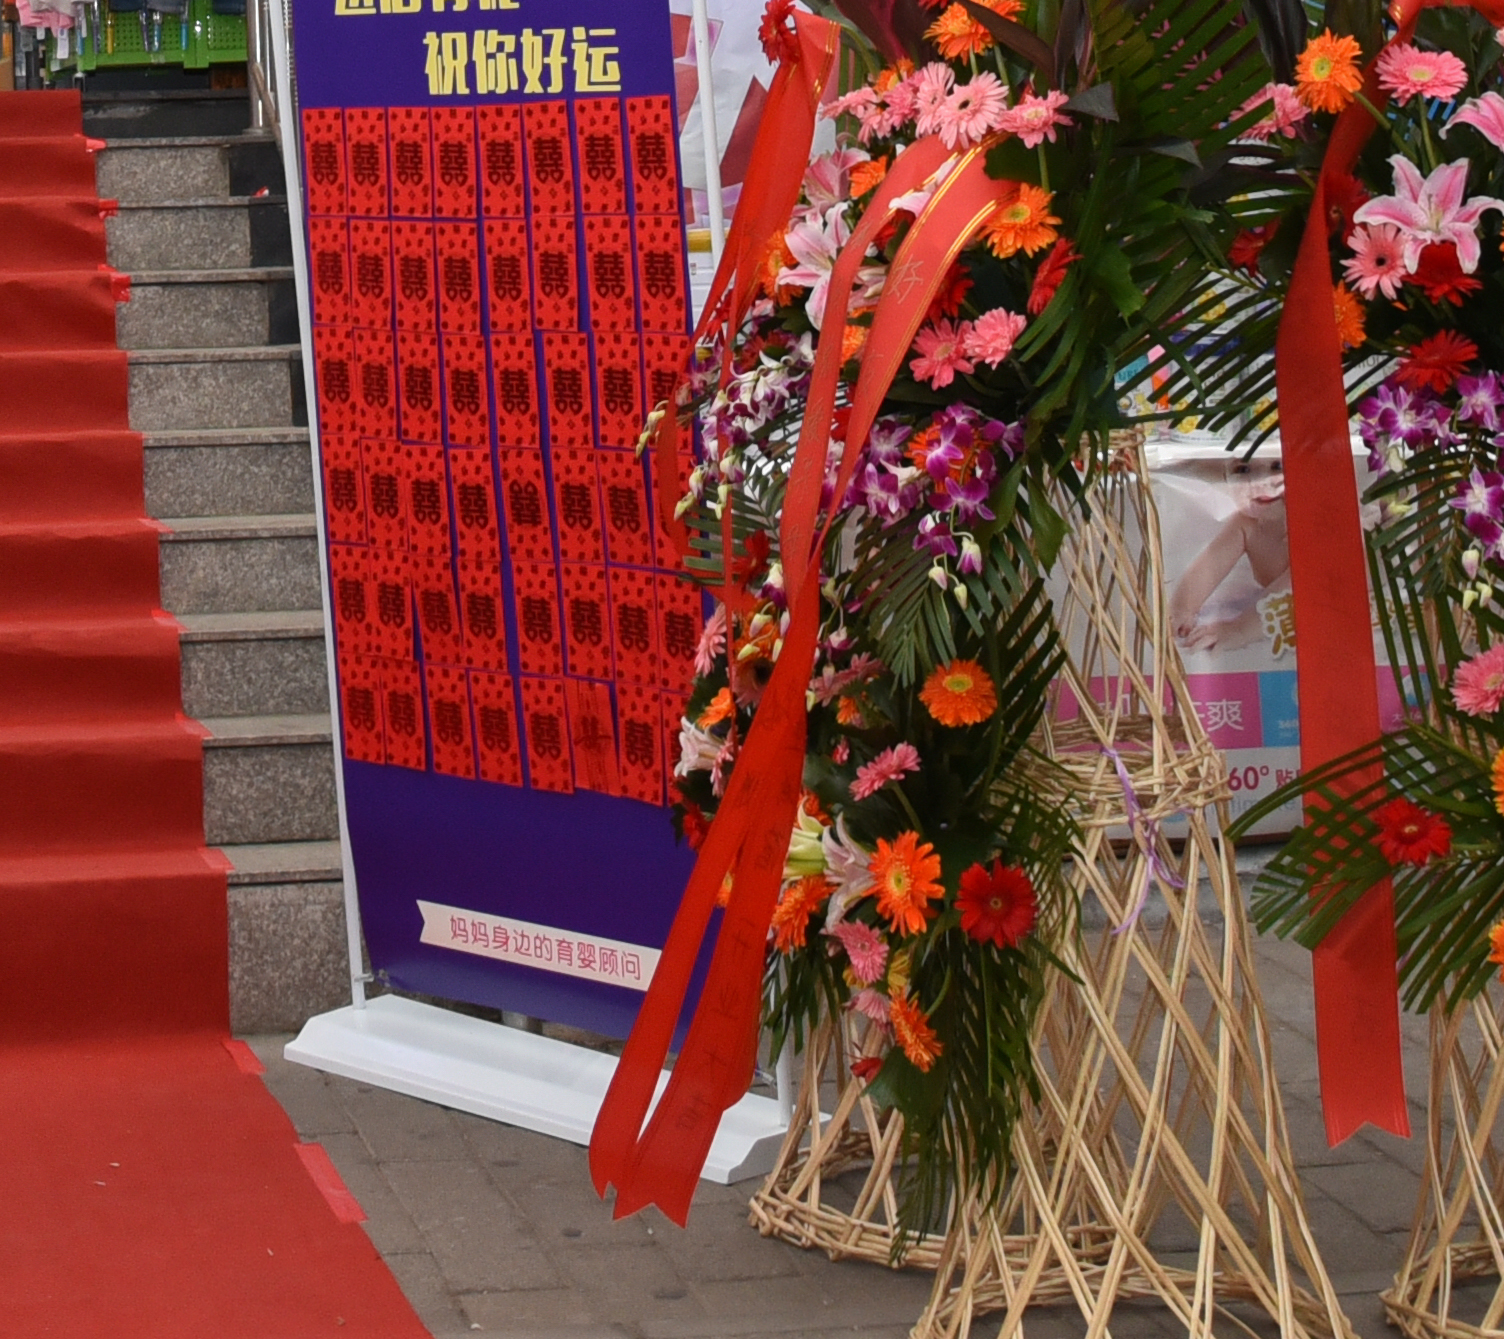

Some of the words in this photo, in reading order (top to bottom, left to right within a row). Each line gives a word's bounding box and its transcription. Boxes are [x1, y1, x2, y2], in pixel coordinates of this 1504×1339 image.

[423, 27, 622, 95] 祝你好运
[449, 913, 642, 982] 妈妈身边的育婴顾问
